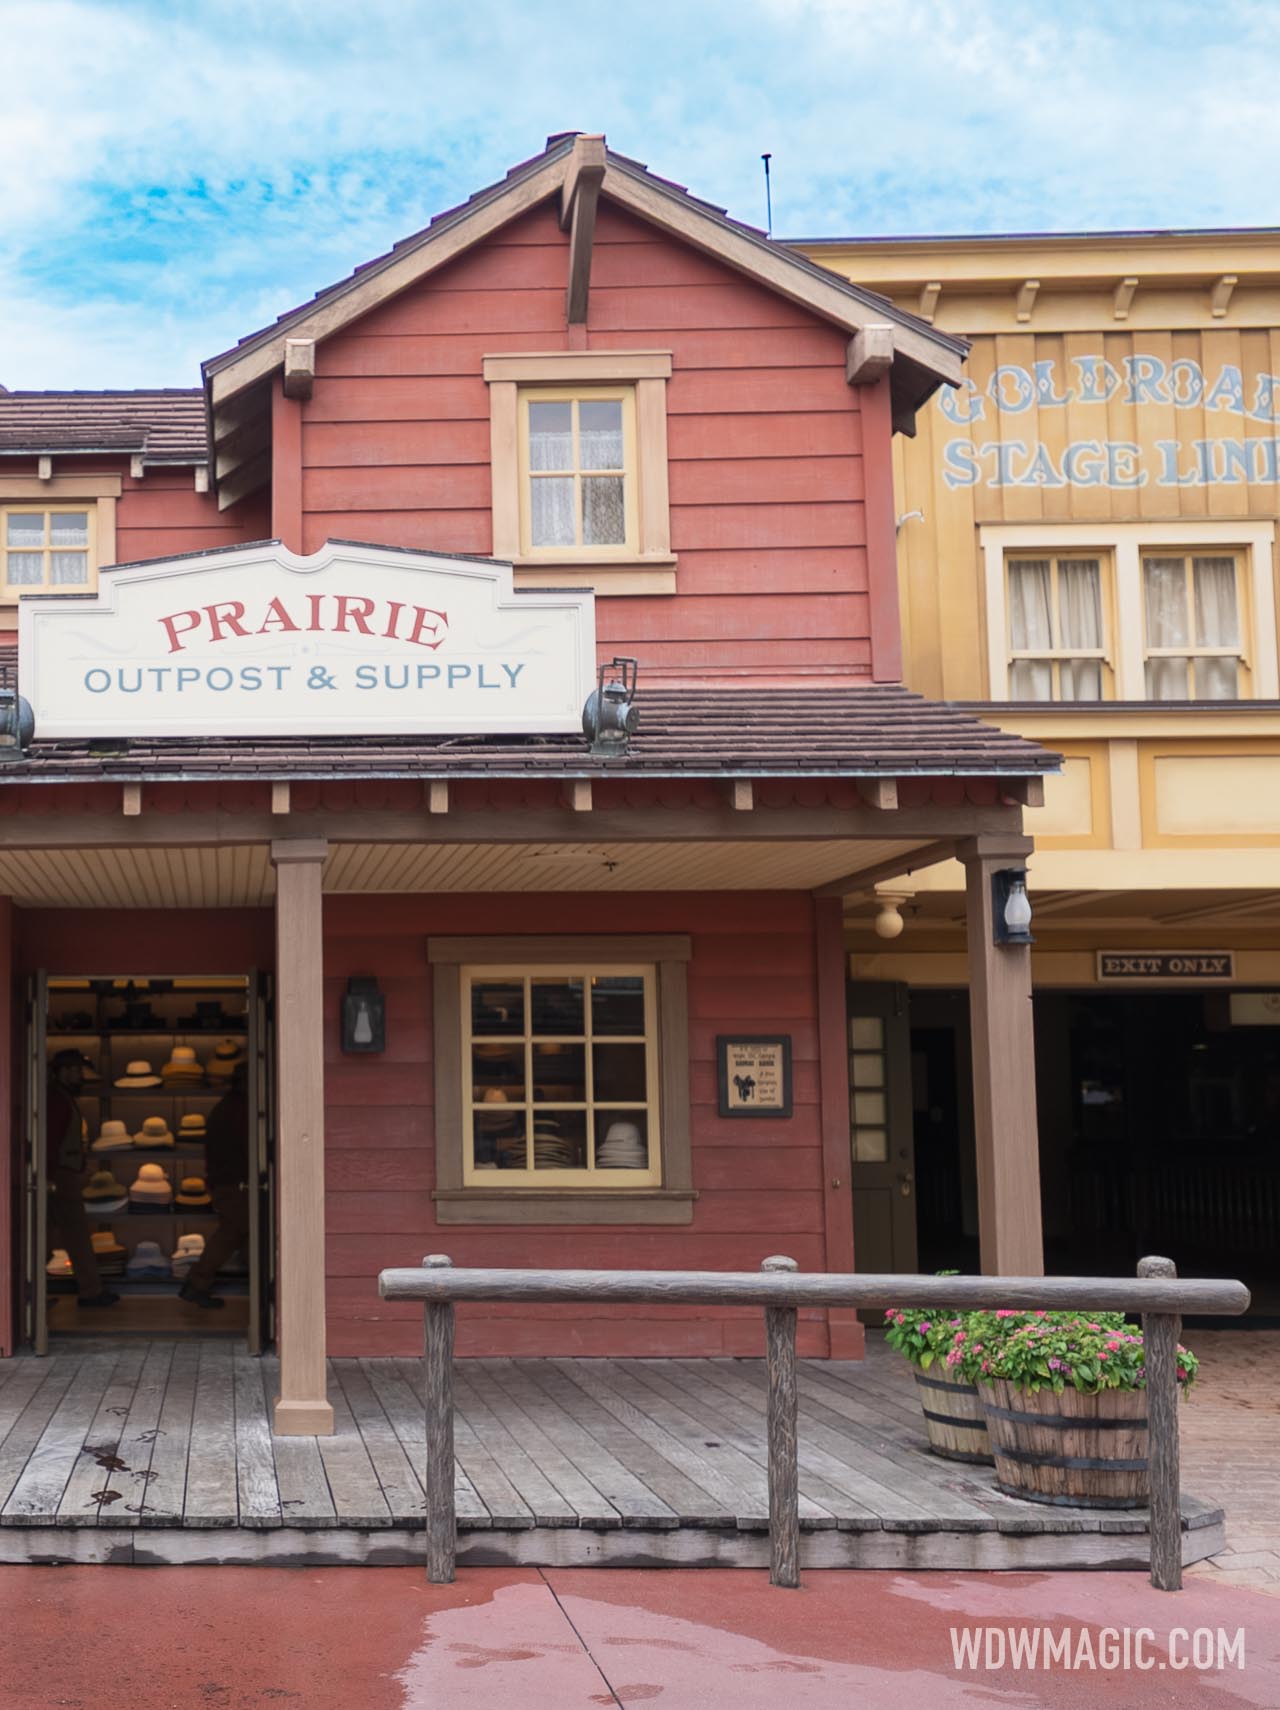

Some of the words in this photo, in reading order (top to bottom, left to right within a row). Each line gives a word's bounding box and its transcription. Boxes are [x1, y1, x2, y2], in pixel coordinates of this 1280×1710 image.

[942, 437, 1148, 491] STAGE
[157, 594, 450, 654] PRAIRIE
[84, 666, 292, 693] OUTPOST
[306, 666, 338, 690] &
[354, 663, 526, 690] SUPPLY
[1104, 958, 1162, 973] EXIT
[1169, 958, 1227, 973] ONLY
